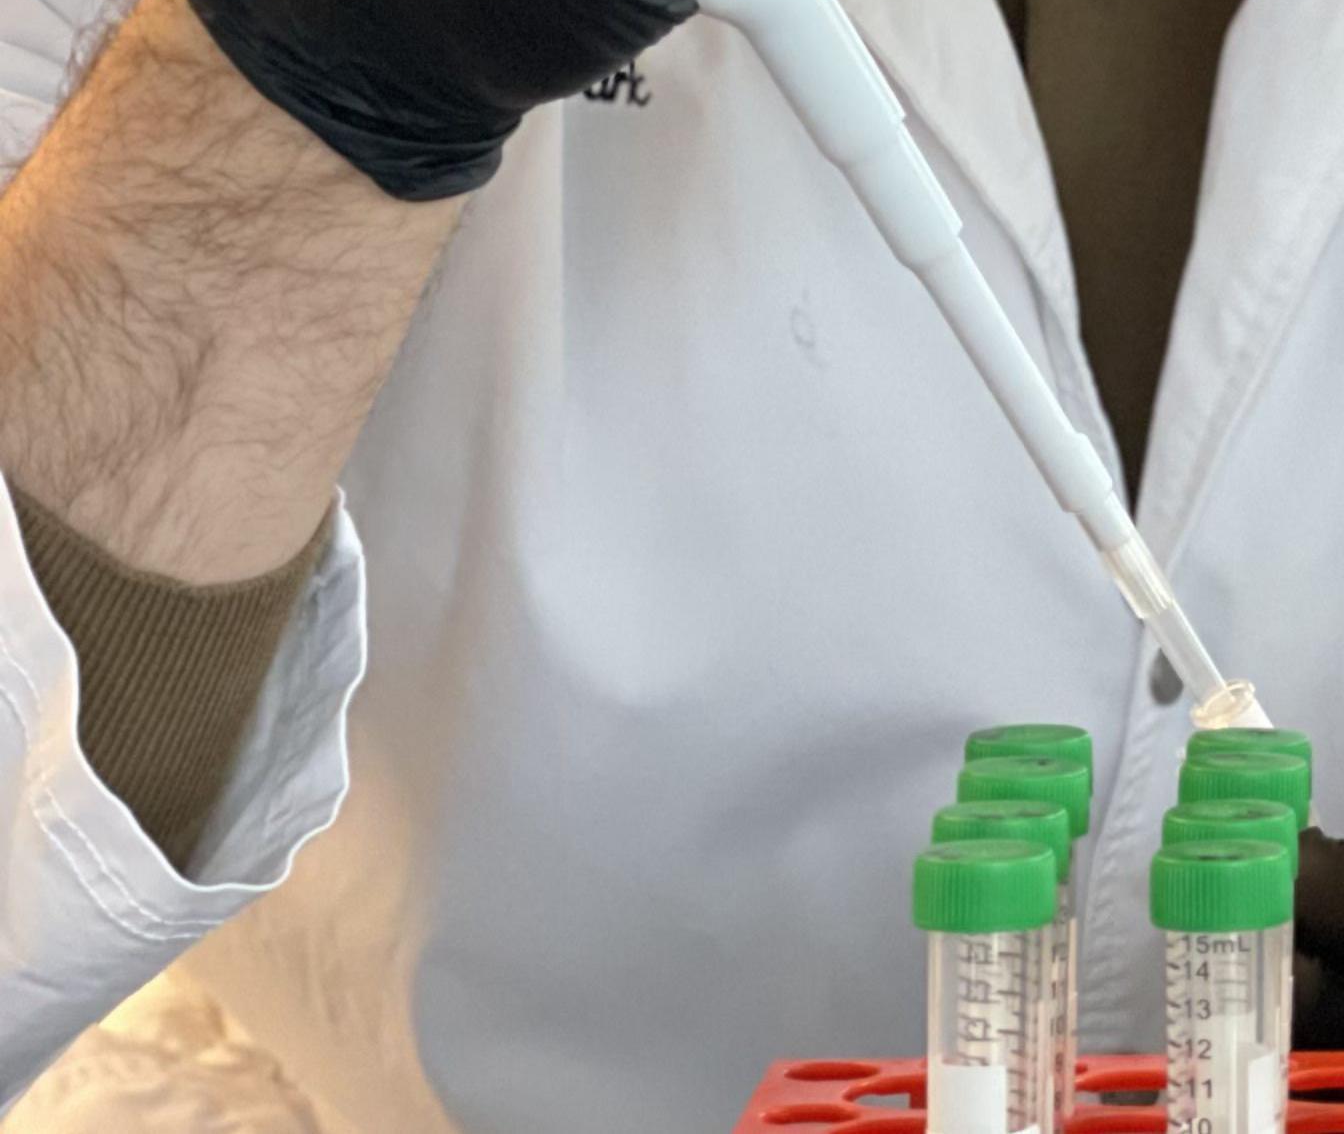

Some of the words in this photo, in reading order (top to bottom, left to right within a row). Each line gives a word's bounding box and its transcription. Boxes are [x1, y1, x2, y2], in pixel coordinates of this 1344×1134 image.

[1181, 934, 1251, 954] 15mL
[1184, 960, 1209, 981] 14
[1183, 998, 1212, 1020] 13
[1185, 1038, 1213, 1060] 12
[1186, 1077, 1213, 1099] 11
